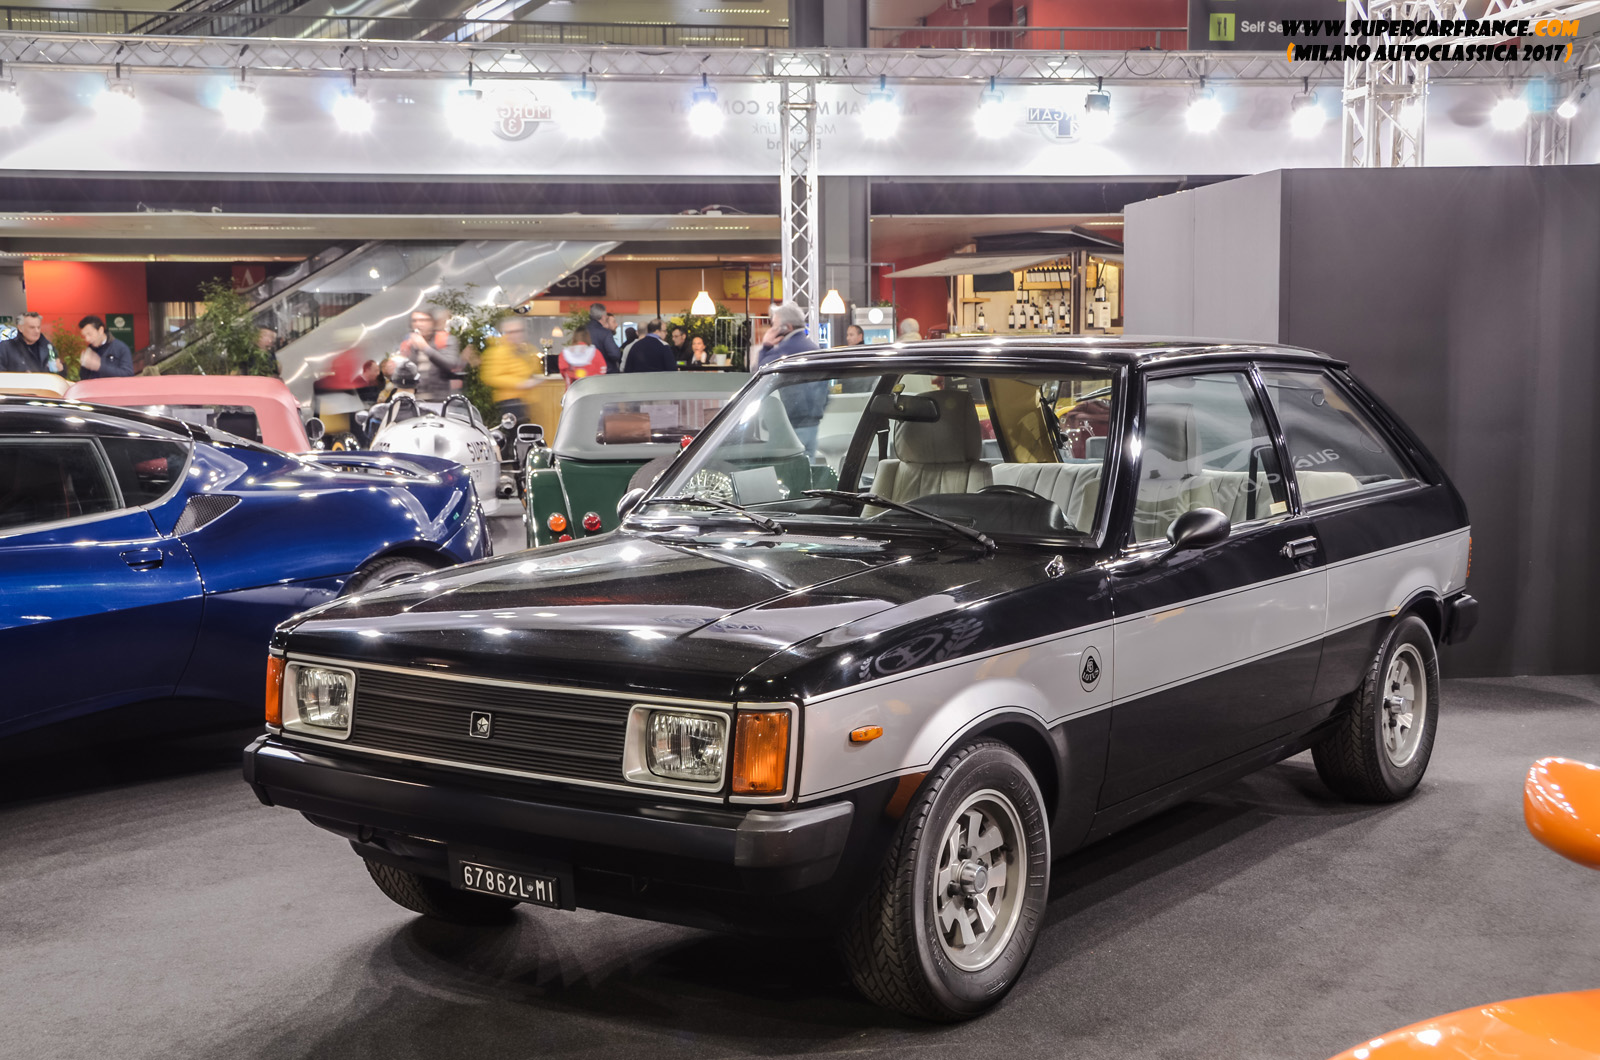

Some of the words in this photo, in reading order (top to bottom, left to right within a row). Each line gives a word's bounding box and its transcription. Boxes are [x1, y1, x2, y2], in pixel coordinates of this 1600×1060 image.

[1240, 20, 1265, 33] Self
[1082, 667, 1099, 681] LOTUS
[464, 866, 529, 898] 67862L
[535, 879, 553, 902] MI
